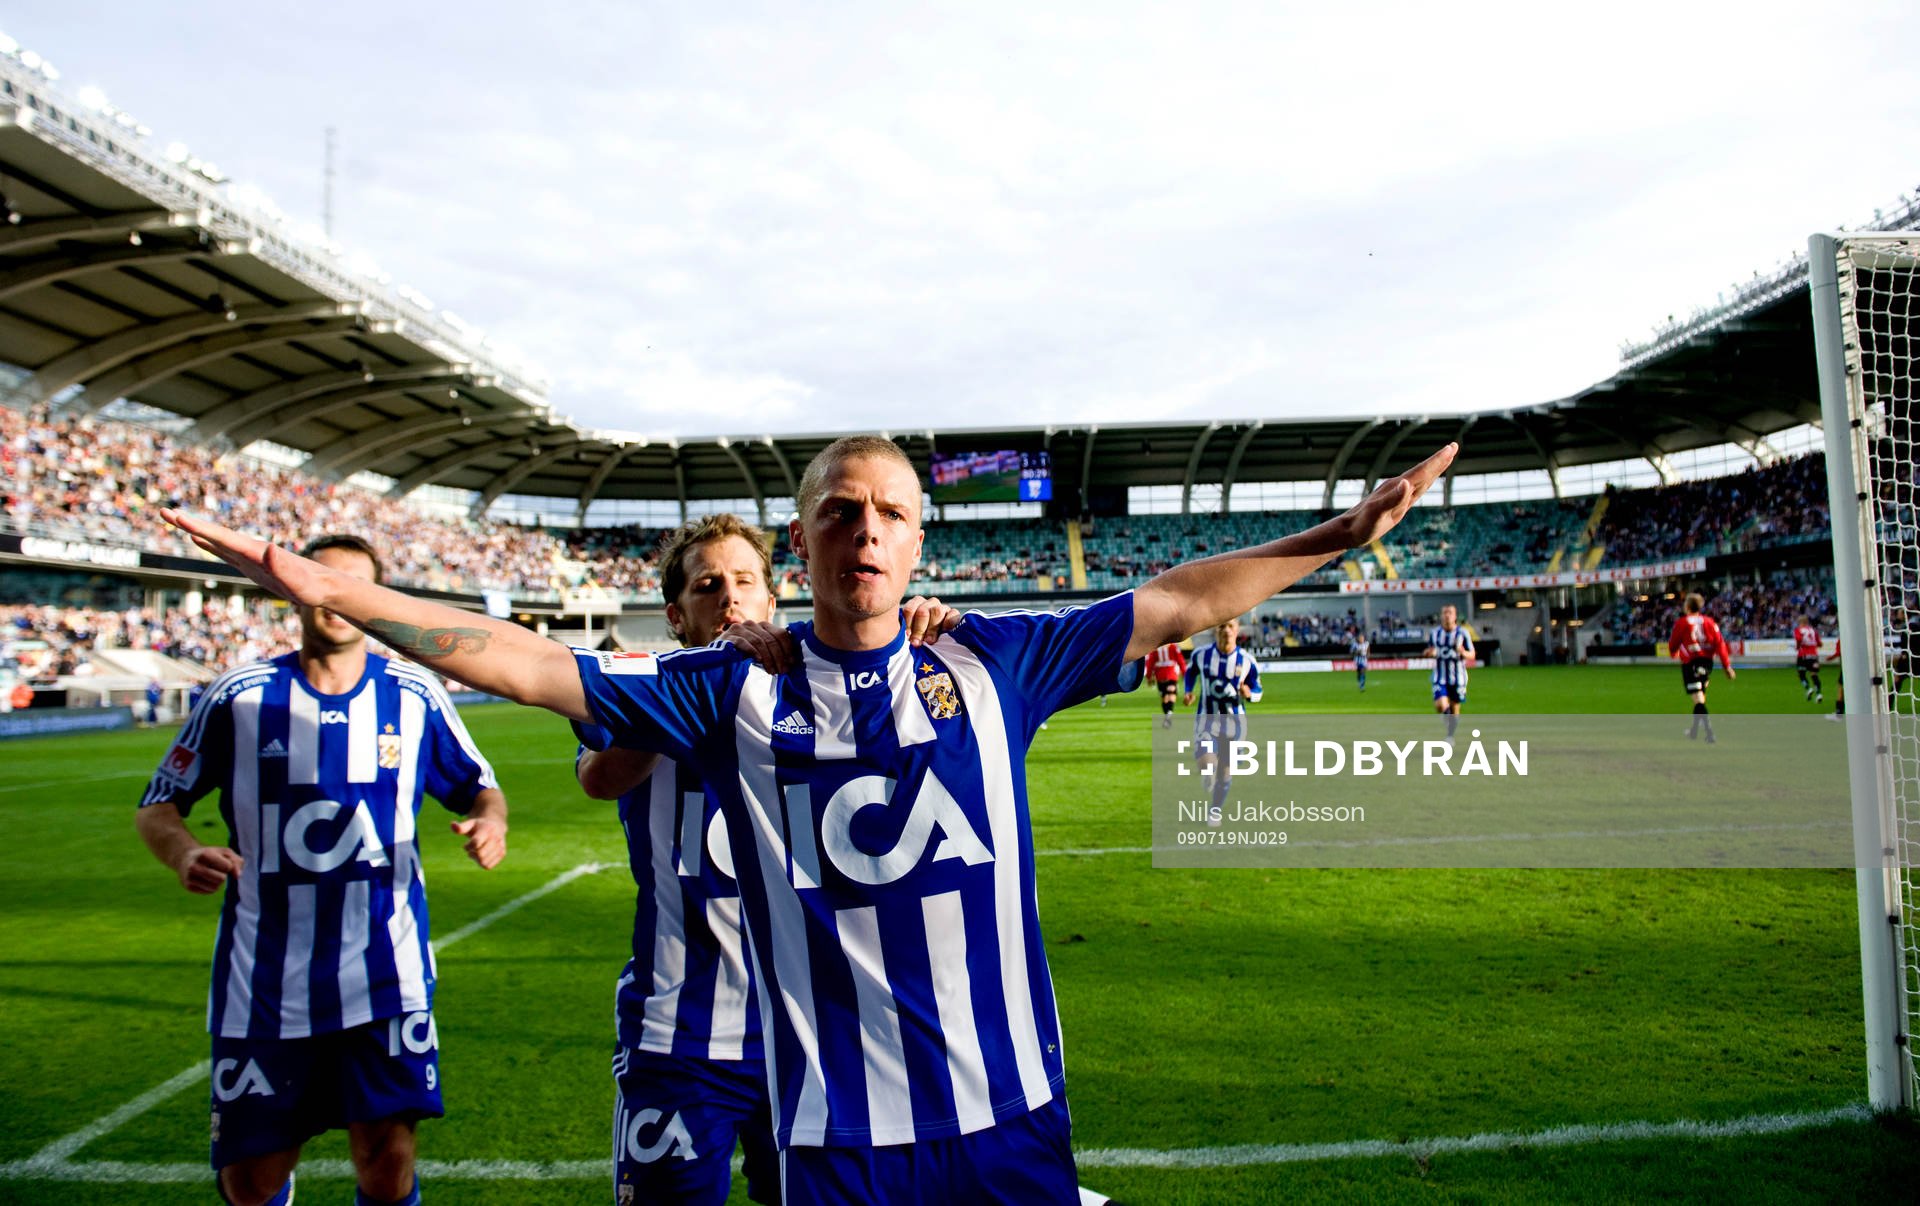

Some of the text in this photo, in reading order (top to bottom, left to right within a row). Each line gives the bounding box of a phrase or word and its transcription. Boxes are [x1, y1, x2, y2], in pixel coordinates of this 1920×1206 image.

[849, 671, 884, 691] ICA
[1206, 680, 1238, 699] ICA
[320, 710, 348, 724] ICA
[773, 724, 814, 735] adidas
[260, 799, 392, 874] ICA
[783, 766, 996, 890] ICA
[213, 1056, 276, 1102] CA
[425, 1063, 437, 1091] 9
[619, 1108, 699, 1164] ICA
